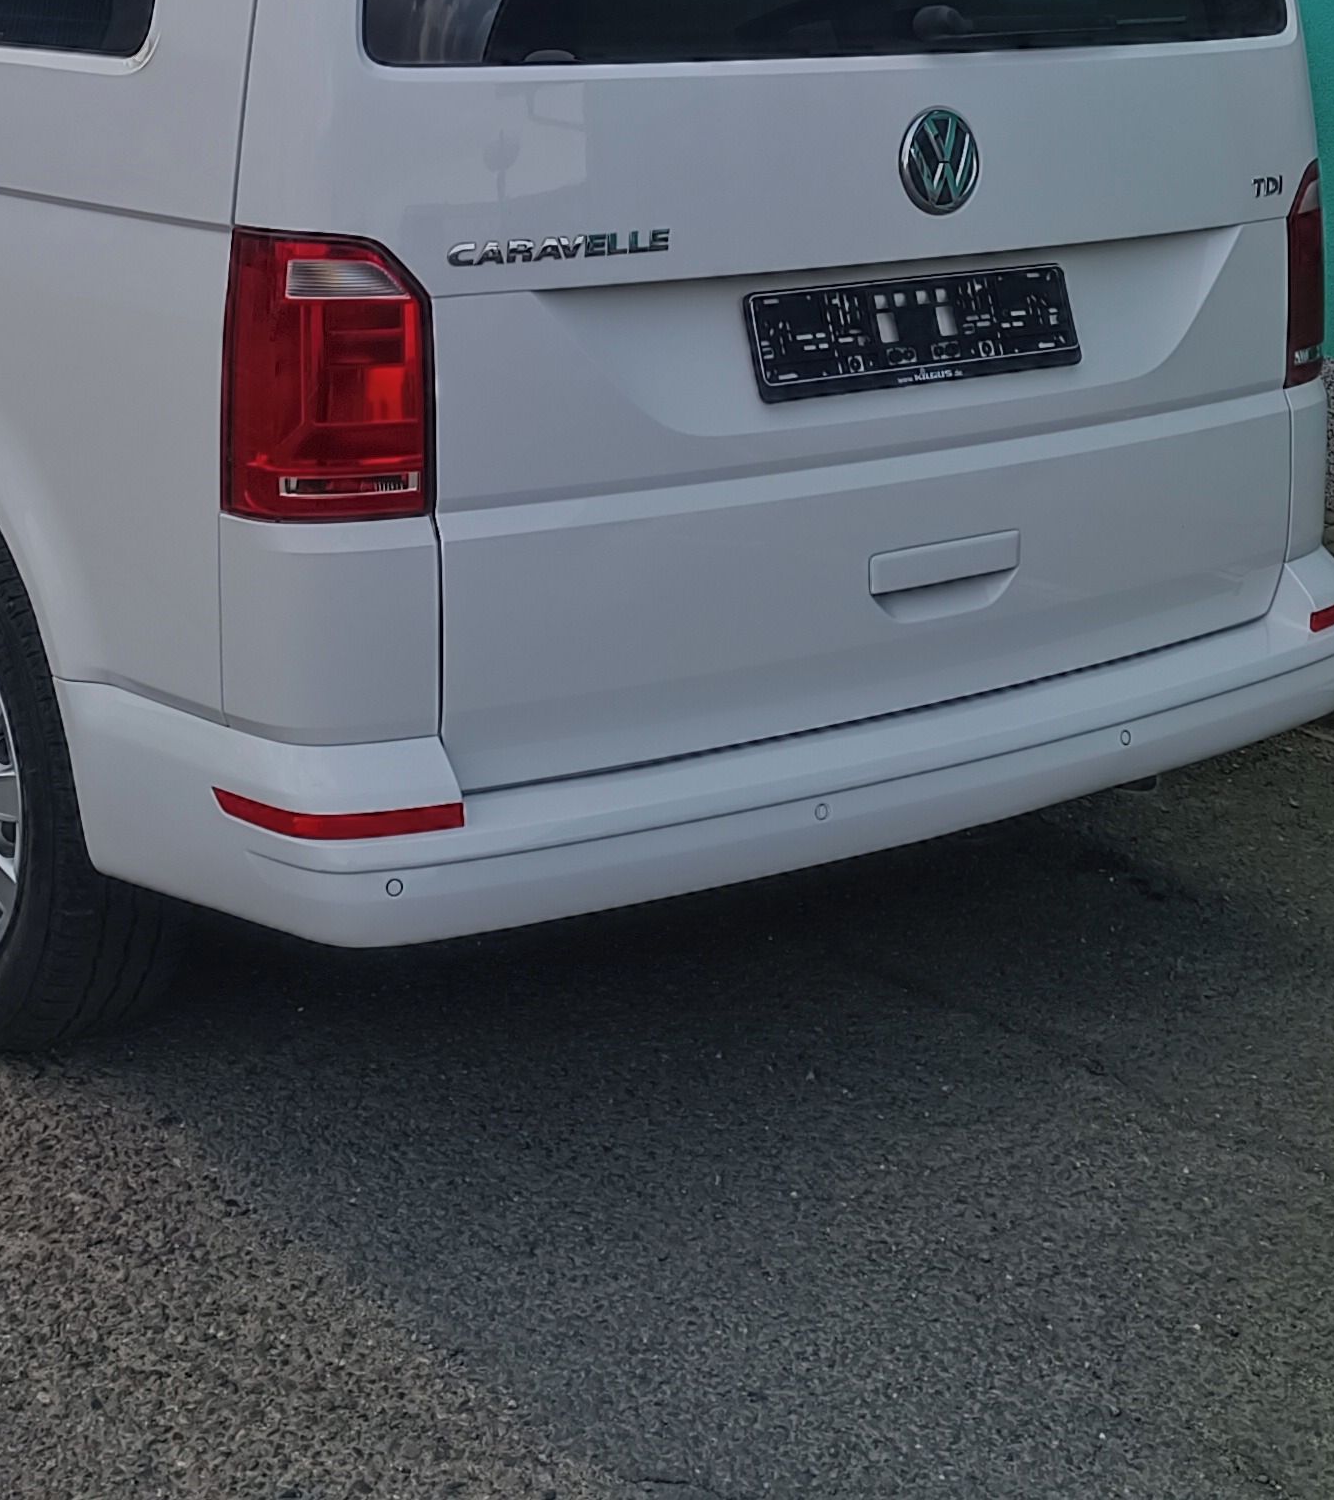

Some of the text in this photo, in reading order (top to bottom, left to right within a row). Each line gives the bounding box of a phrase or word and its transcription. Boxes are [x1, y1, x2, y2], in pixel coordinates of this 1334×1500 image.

[902, 109, 977, 211] VW
[1252, 175, 1283, 198] TDI
[447, 228, 670, 267] CARAVELLE
